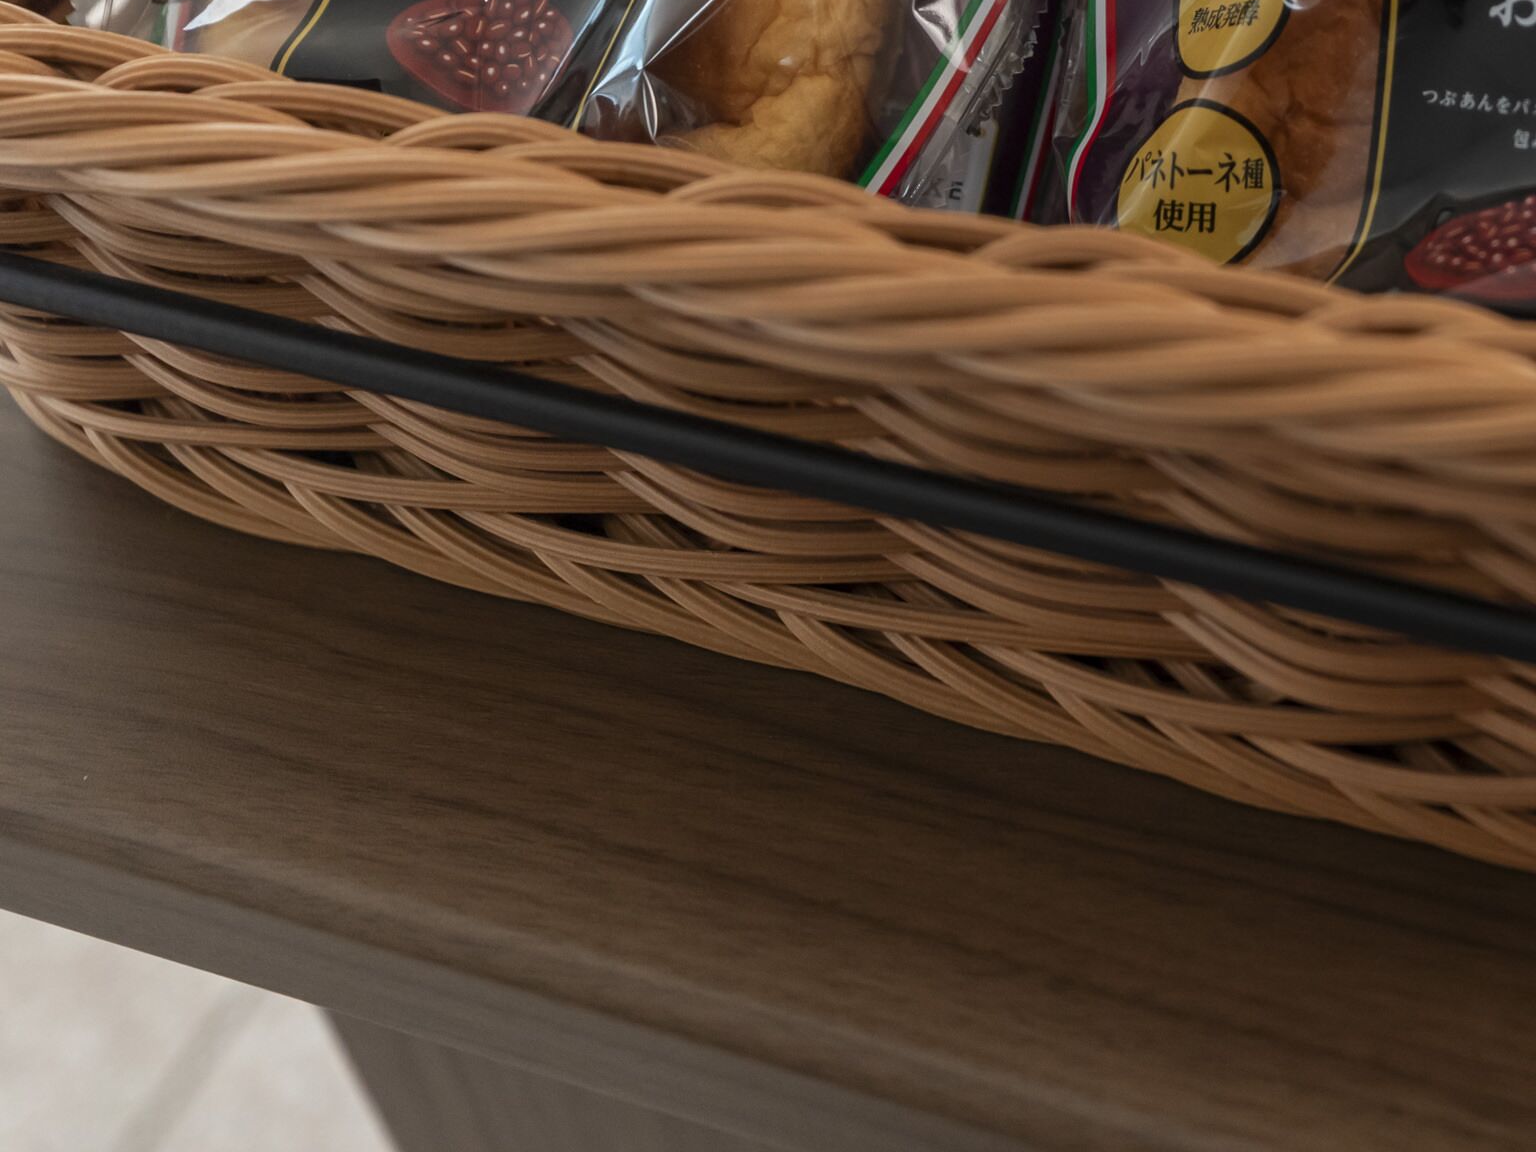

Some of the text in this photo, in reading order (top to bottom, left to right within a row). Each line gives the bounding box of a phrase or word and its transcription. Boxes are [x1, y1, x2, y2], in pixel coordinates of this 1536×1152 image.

[1125, 149, 1265, 193] パネトーネ種
[1153, 198, 1217, 234] 使用
